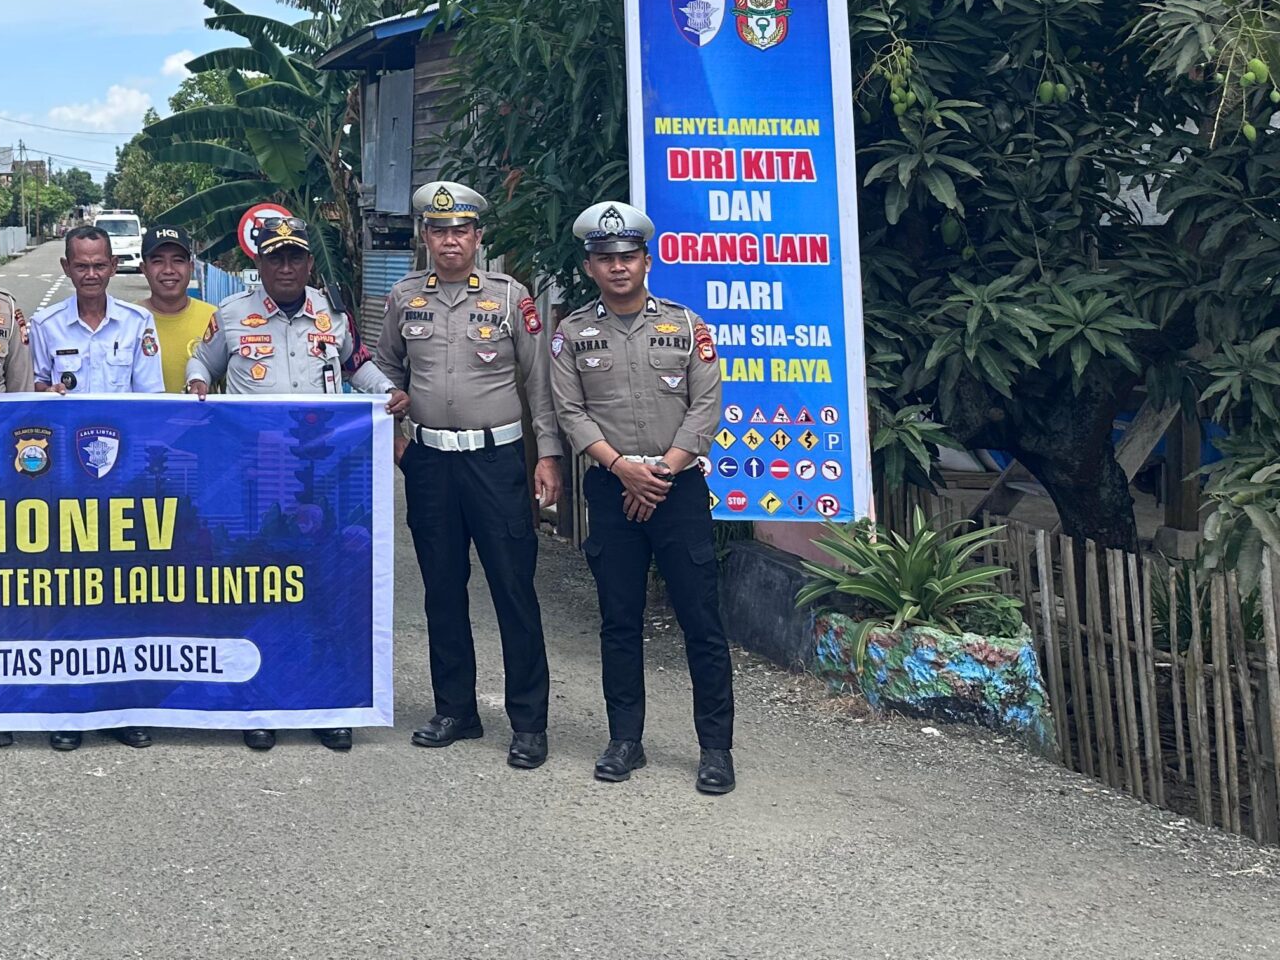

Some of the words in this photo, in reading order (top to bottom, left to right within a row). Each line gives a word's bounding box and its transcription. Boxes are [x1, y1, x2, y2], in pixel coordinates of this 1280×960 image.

[654, 117, 820, 136] MENYELAMATKAN
[667, 147, 735, 182] DIRI
[735, 148, 816, 183] KITA
[708, 190, 772, 222] DAN
[658, 232, 759, 265] ORANG
[763, 234, 829, 266] LAIN
[707, 280, 783, 311] DARI
[575, 340, 608, 352] ASHAR
[650, 337, 689, 350] POLRI
[706, 324, 746, 346] BAN
[750, 324, 832, 347] SIA-SIA
[719, 358, 764, 382] LAN
[770, 358, 832, 383] RAYA
[727, 496, 746, 506] STOP
[113, 565, 186, 605] LALU
[195, 564, 304, 605] LINTAS
[50, 646, 127, 676] POLDA
[134, 644, 223, 674] SULSEL
